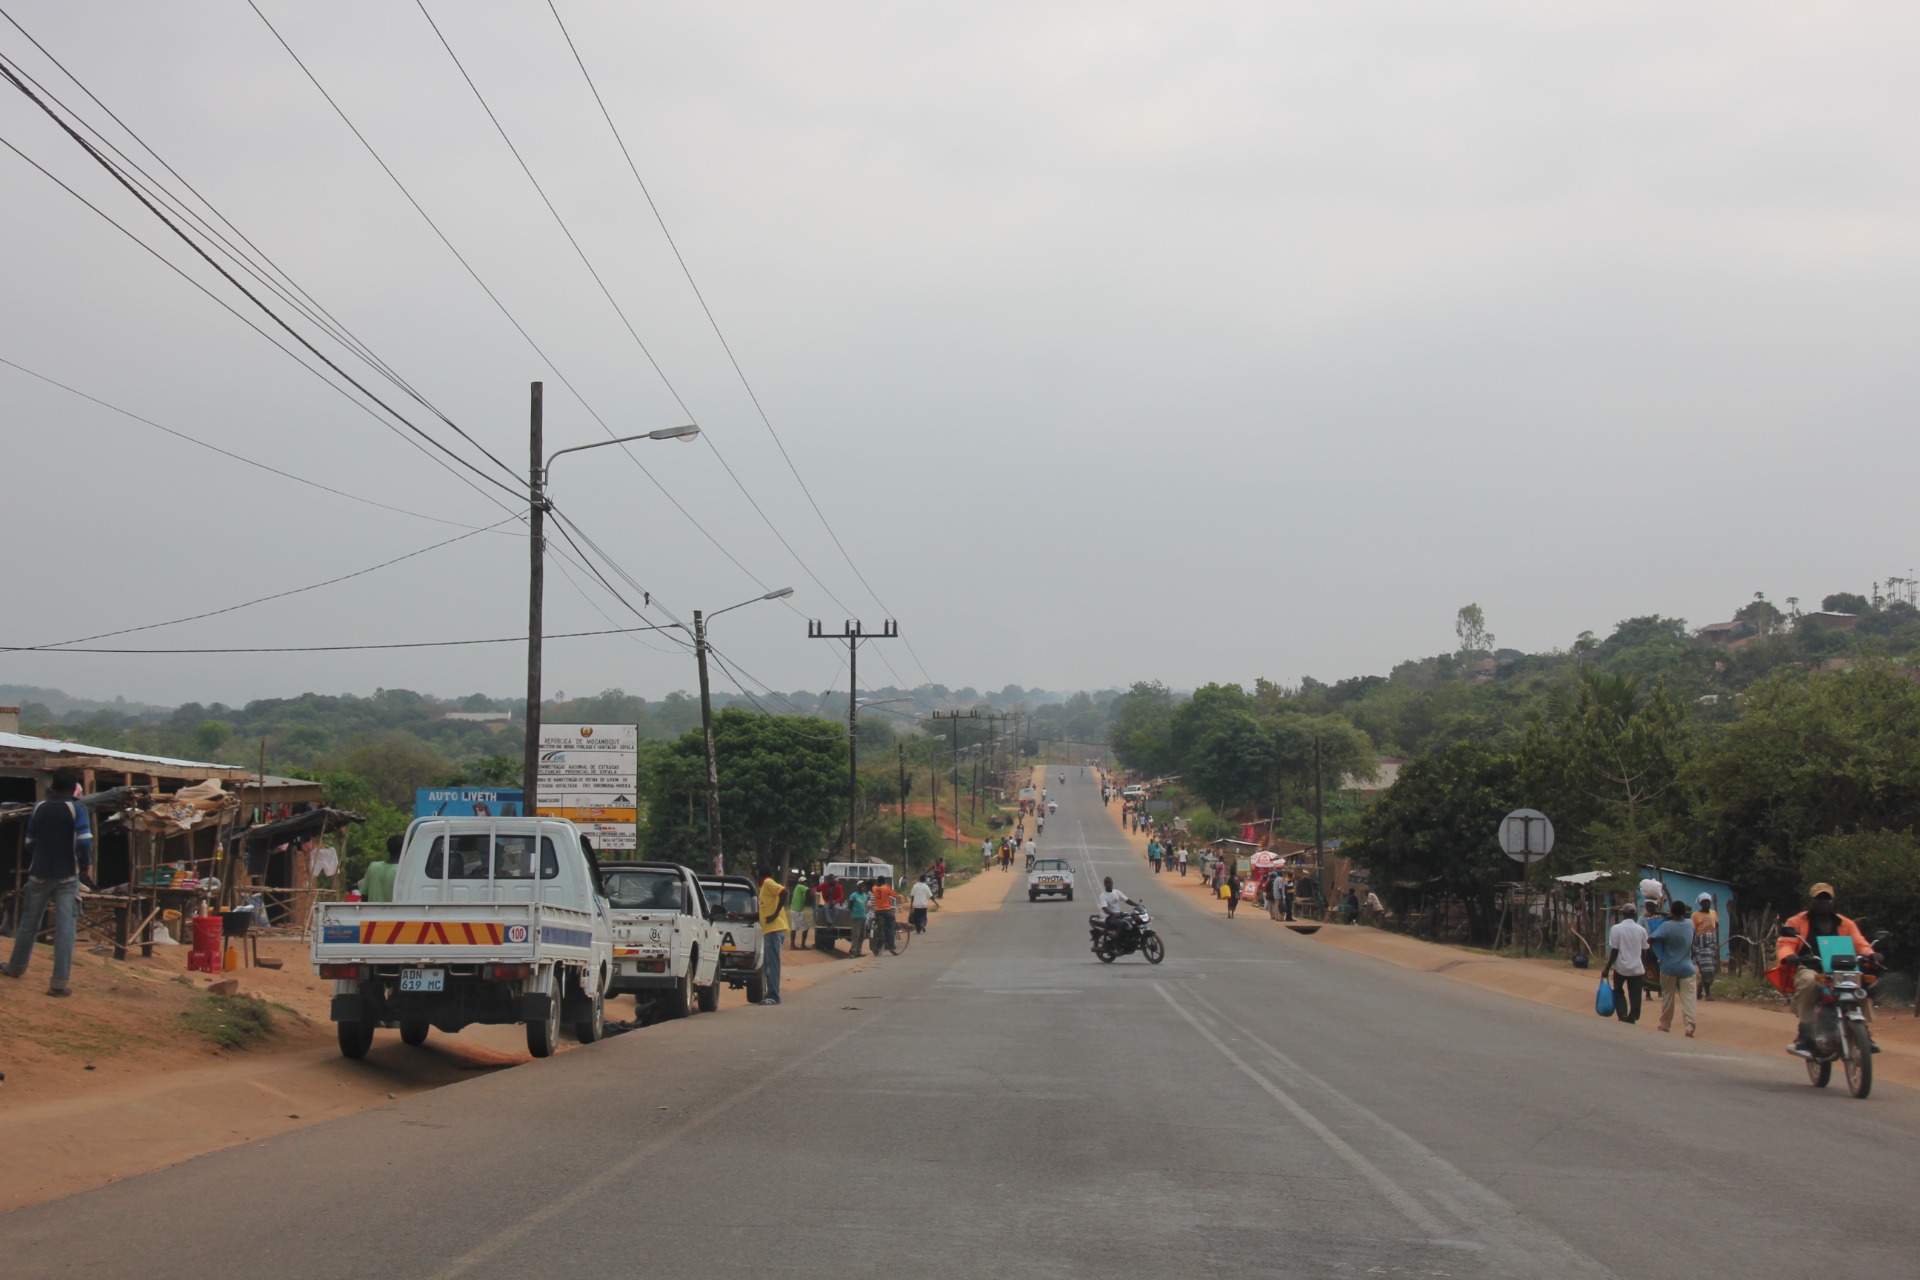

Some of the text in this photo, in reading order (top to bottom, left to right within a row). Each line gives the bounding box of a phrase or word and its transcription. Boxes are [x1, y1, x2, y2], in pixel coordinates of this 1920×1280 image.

[429, 792, 497, 802] AUTO LIVETH
[511, 928, 524, 940] 100
[402, 969, 422, 980] ADN
[401, 980, 441, 990] 619 MC
